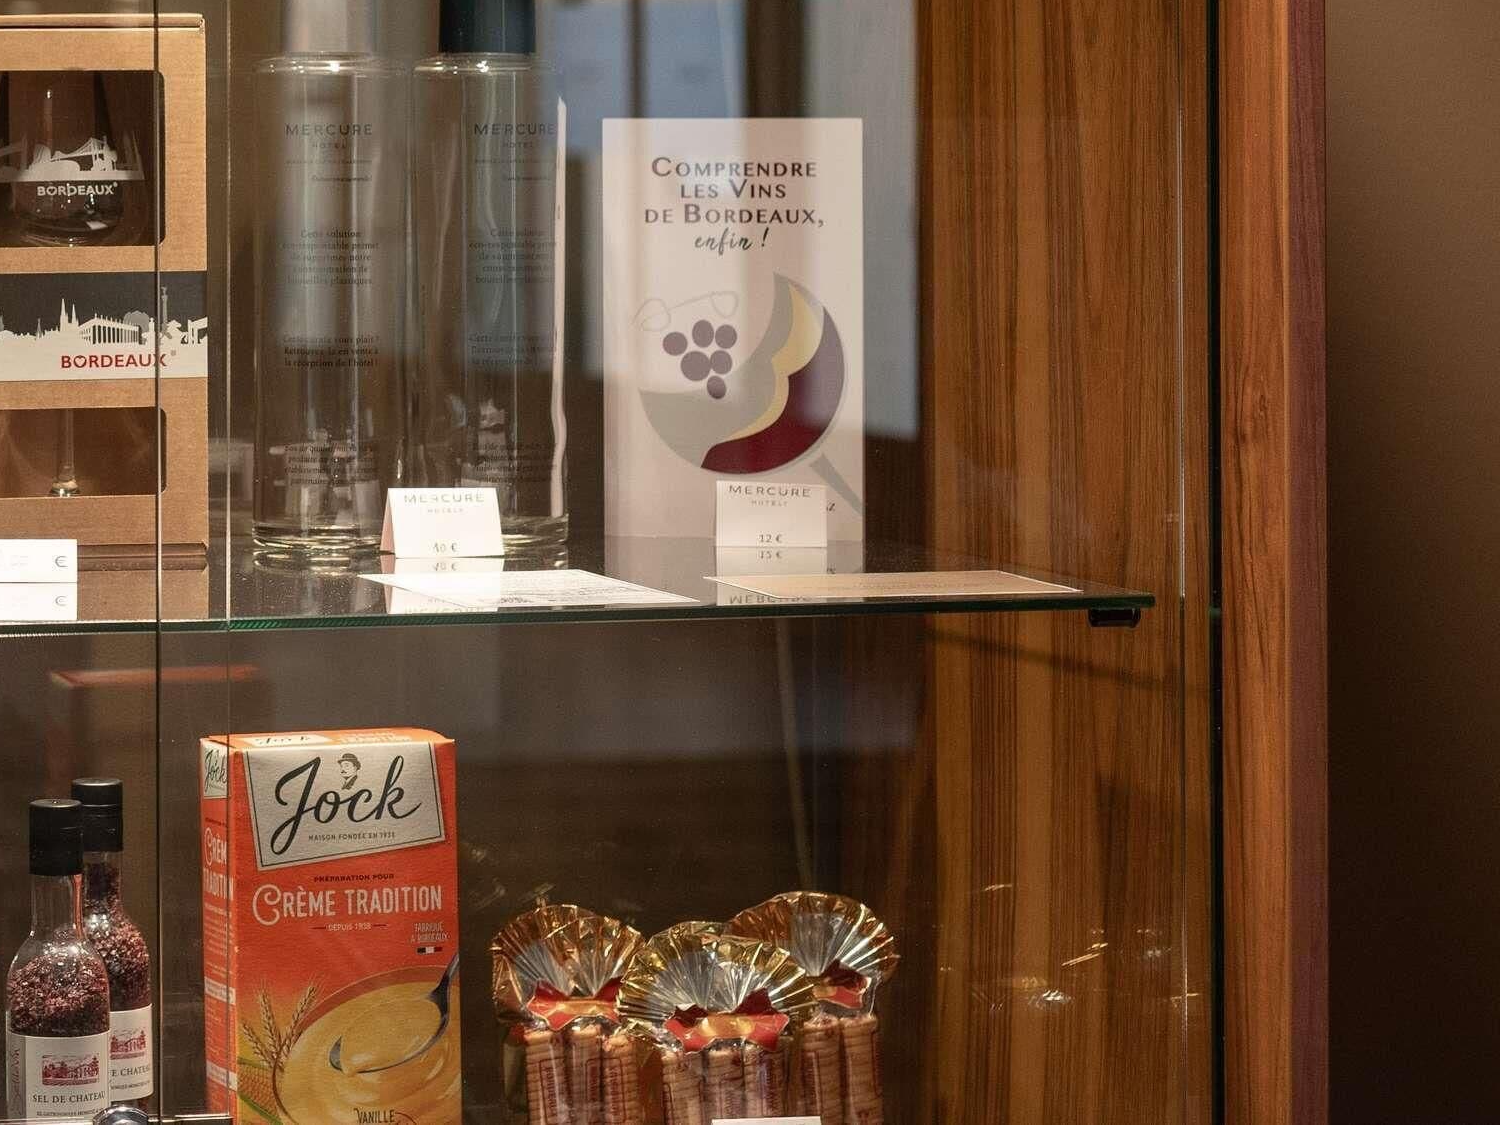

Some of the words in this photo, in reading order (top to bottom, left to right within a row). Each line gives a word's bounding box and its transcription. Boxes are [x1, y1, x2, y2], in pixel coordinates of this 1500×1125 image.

[284, 123, 373, 136] MERCURE
[474, 123, 557, 136] MERCURE
[651, 156, 818, 177] COMPRENDRE
[36, 184, 114, 197] BORDEAUX
[680, 183, 719, 199] LES
[728, 178, 787, 199] VINS
[644, 208, 674, 224] DE
[683, 203, 824, 228] BORDEAUX,
[694, 227, 753, 255] enfin
[60, 353, 167, 369] BORDEAUX
[728, 484, 812, 498] MERCURE
[403, 493, 485, 504] MERCURE
[758, 533, 773, 543] 12
[775, 533, 783, 543] €
[451, 542, 460, 554] €
[54, 555, 69, 568] €
[270, 754, 422, 856] Jock
[308, 833, 336, 842] MAISON
[204, 826, 227, 866] CRÈM
[252, 883, 336, 926] CRÈME
[344, 885, 442, 916] TRADITION
[32, 1094, 49, 1103] SEL
[52, 1094, 66, 1104] DE
[353, 1107, 395, 1124] VANILLE
